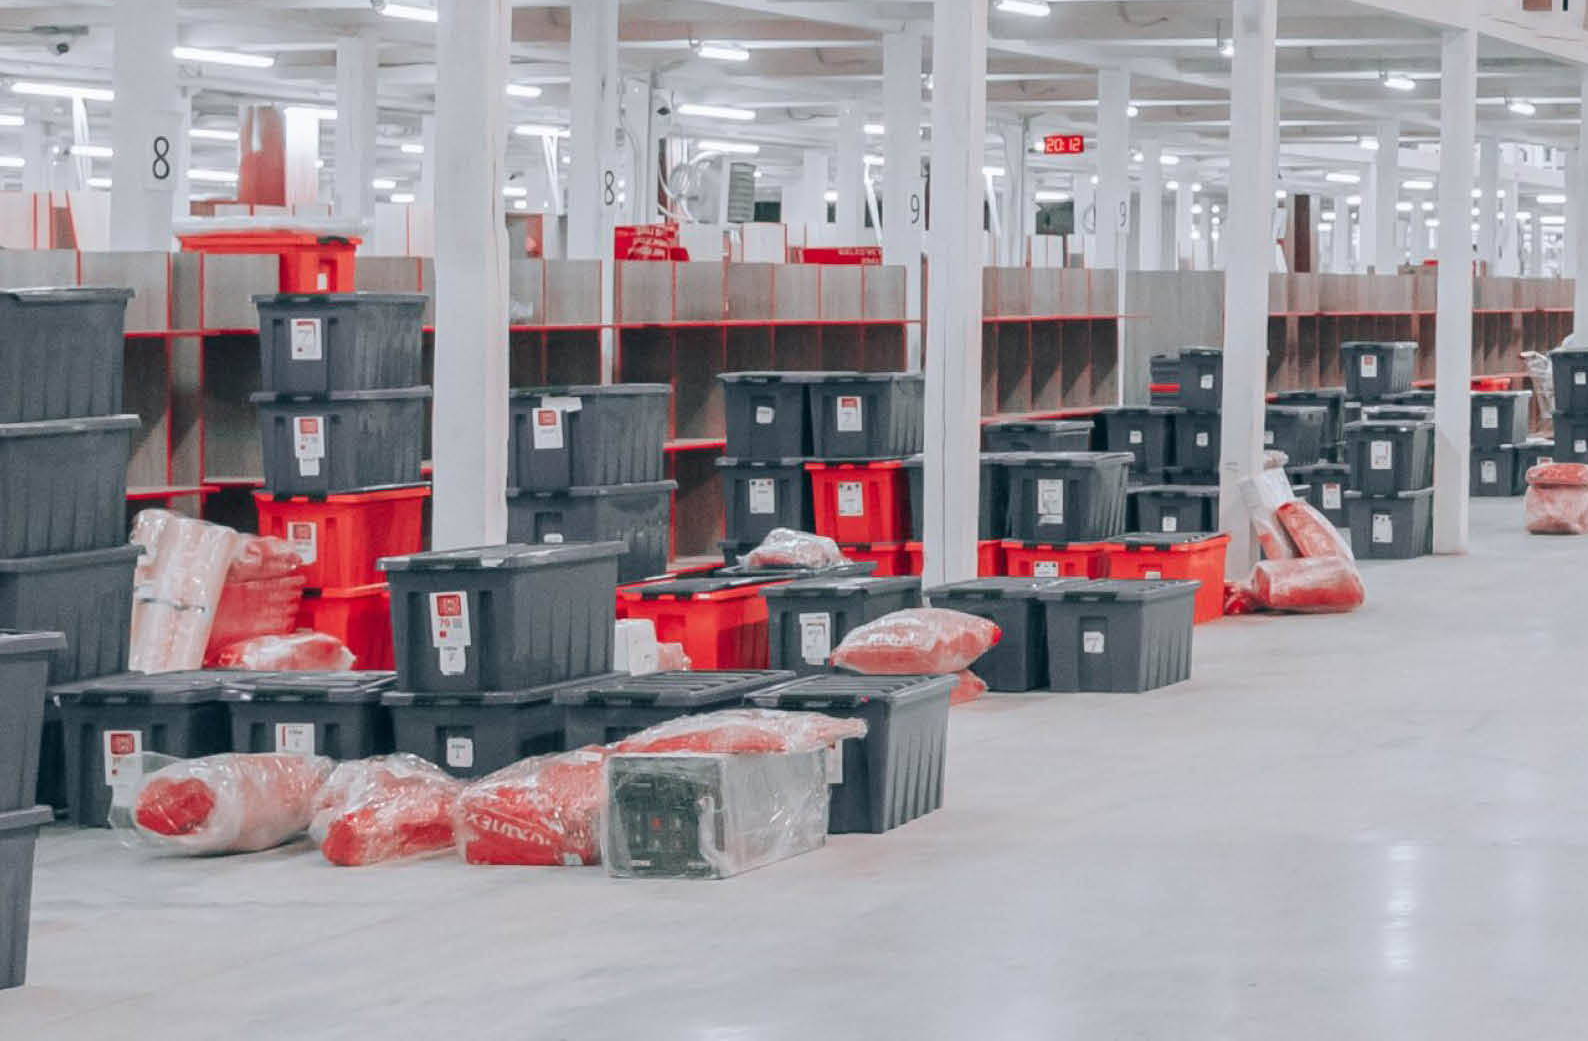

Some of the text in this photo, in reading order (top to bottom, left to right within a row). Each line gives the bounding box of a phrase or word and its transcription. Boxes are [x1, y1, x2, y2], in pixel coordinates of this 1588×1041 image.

[152, 135, 170, 180] 8
[603, 170, 615, 206] 8
[910, 193, 920, 224] 9
[1119, 200, 1127, 227] 9
